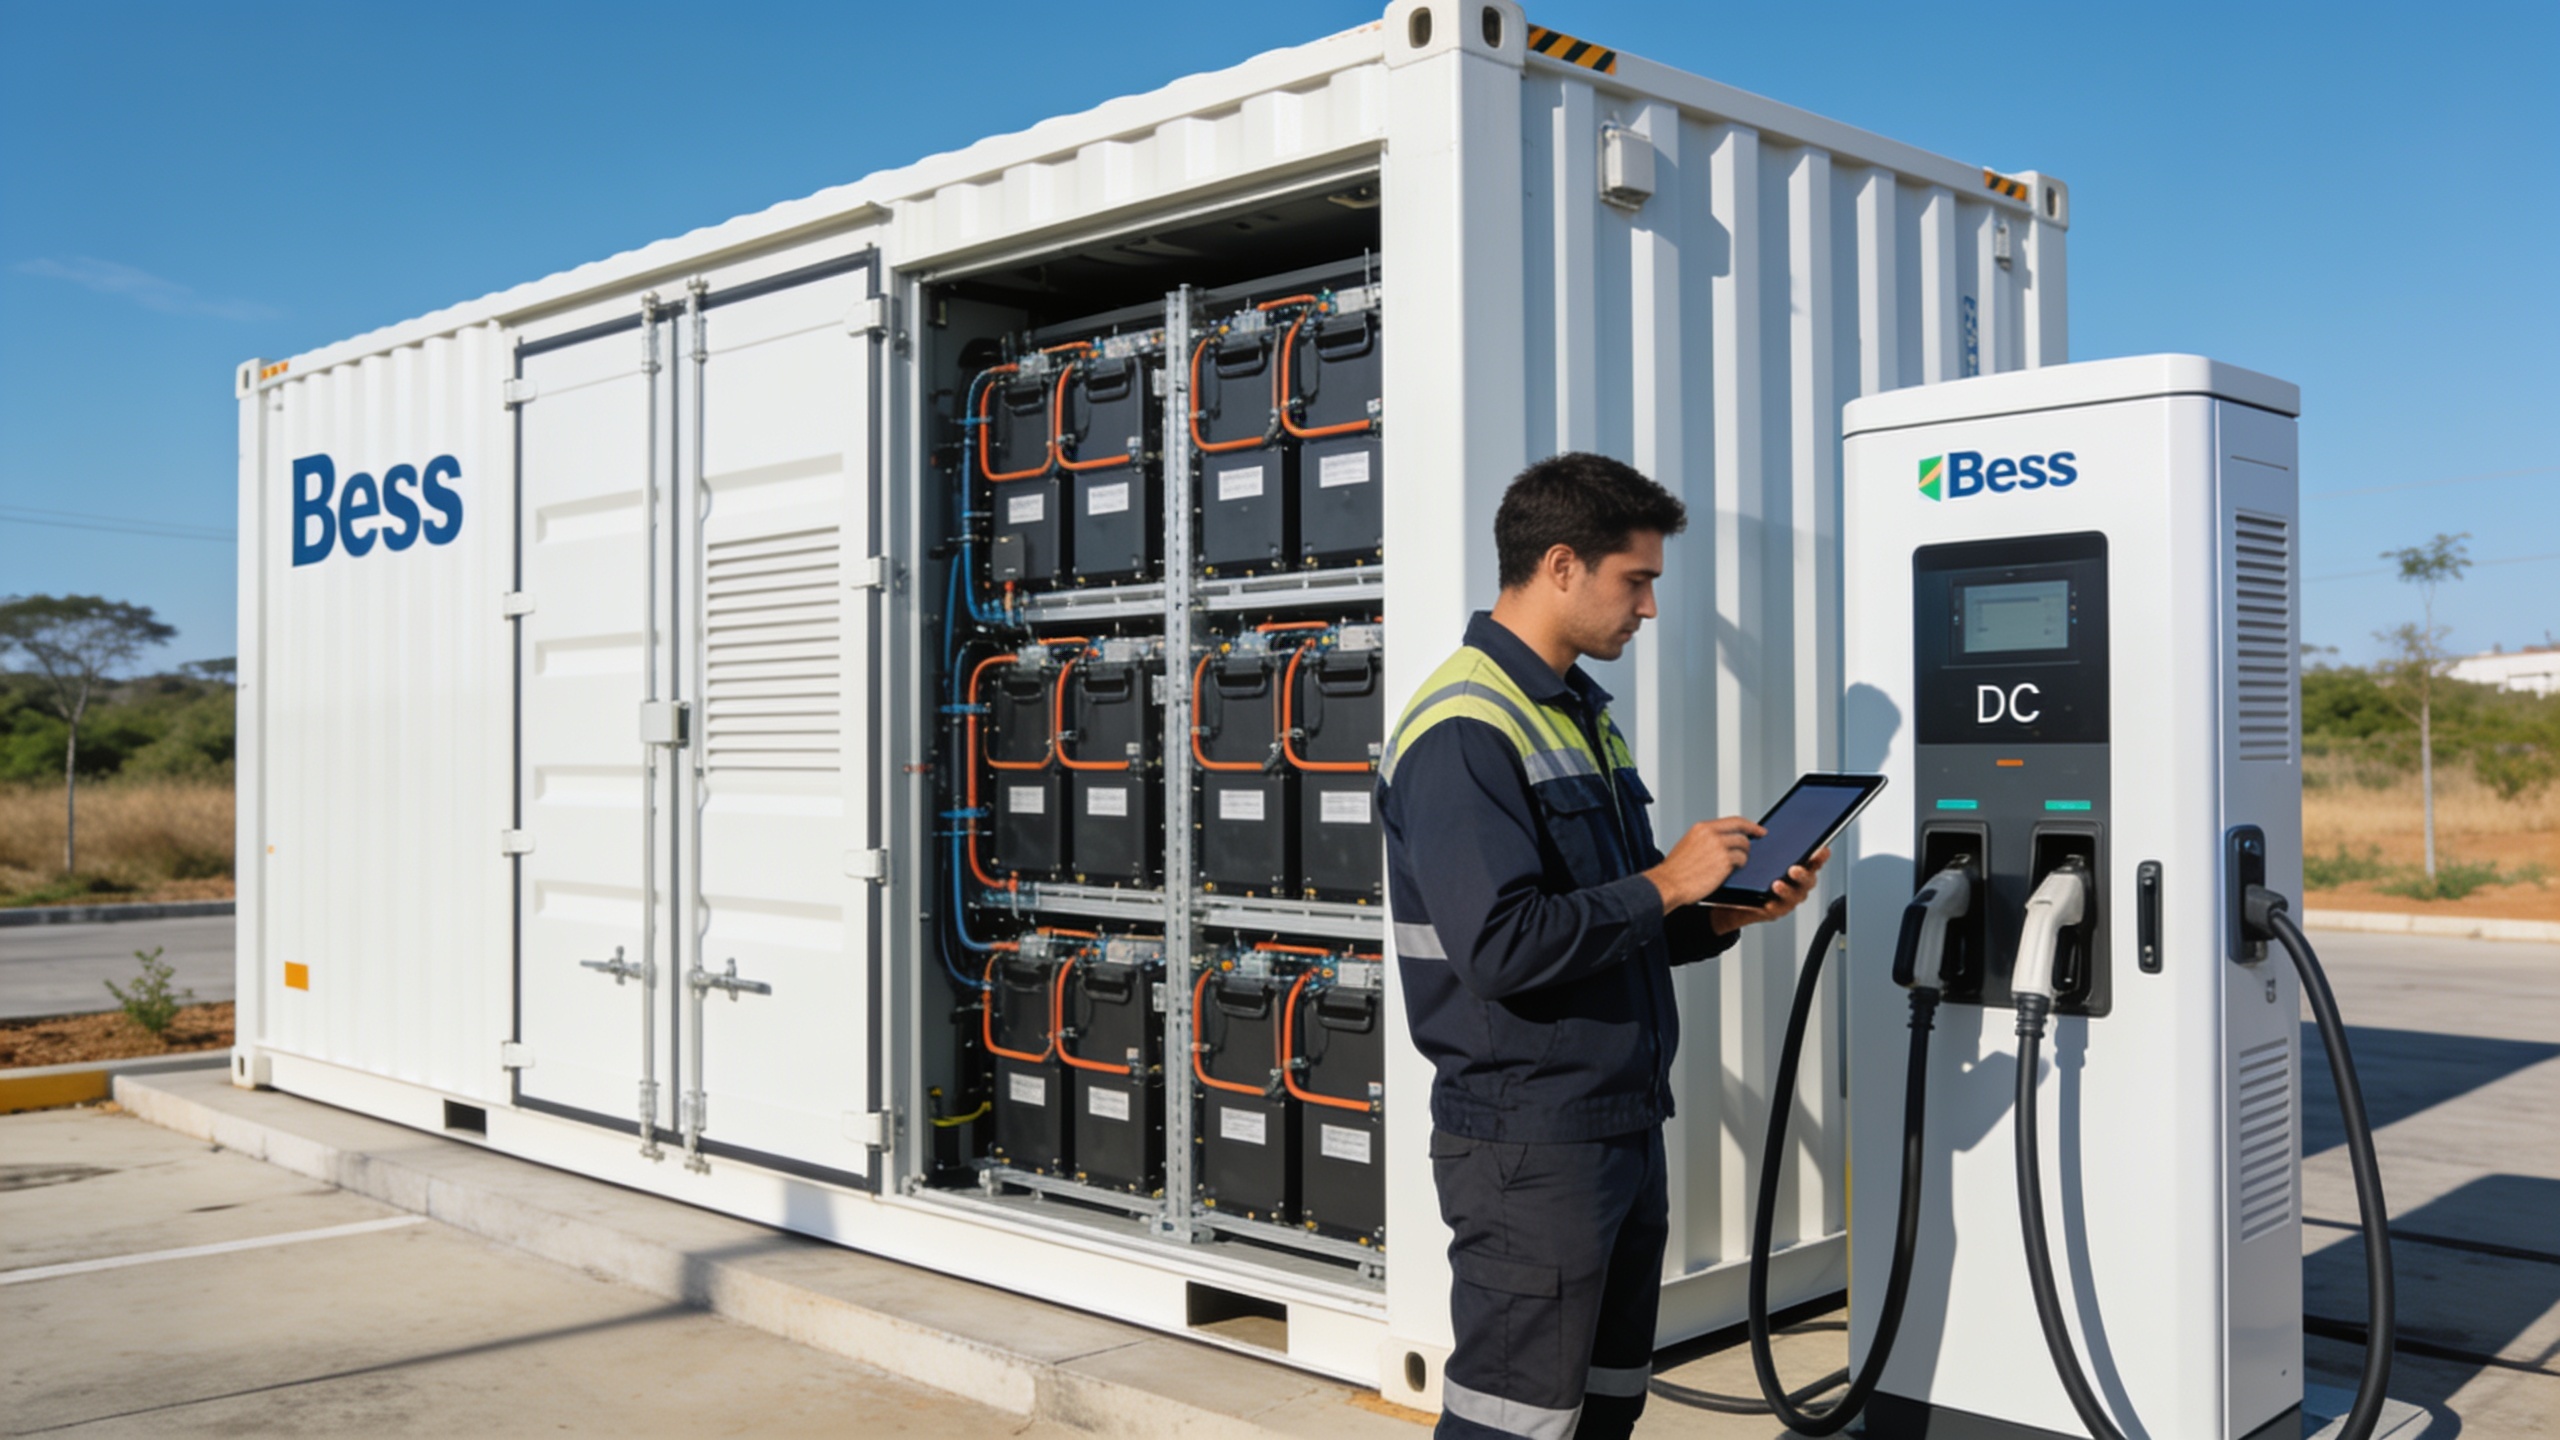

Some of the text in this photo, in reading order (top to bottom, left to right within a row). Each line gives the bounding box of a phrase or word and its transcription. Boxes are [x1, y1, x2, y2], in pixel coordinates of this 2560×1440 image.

[1948, 450, 2078, 499] Bess
[292, 453, 463, 567] Bess
[1977, 682, 2041, 724] DC
